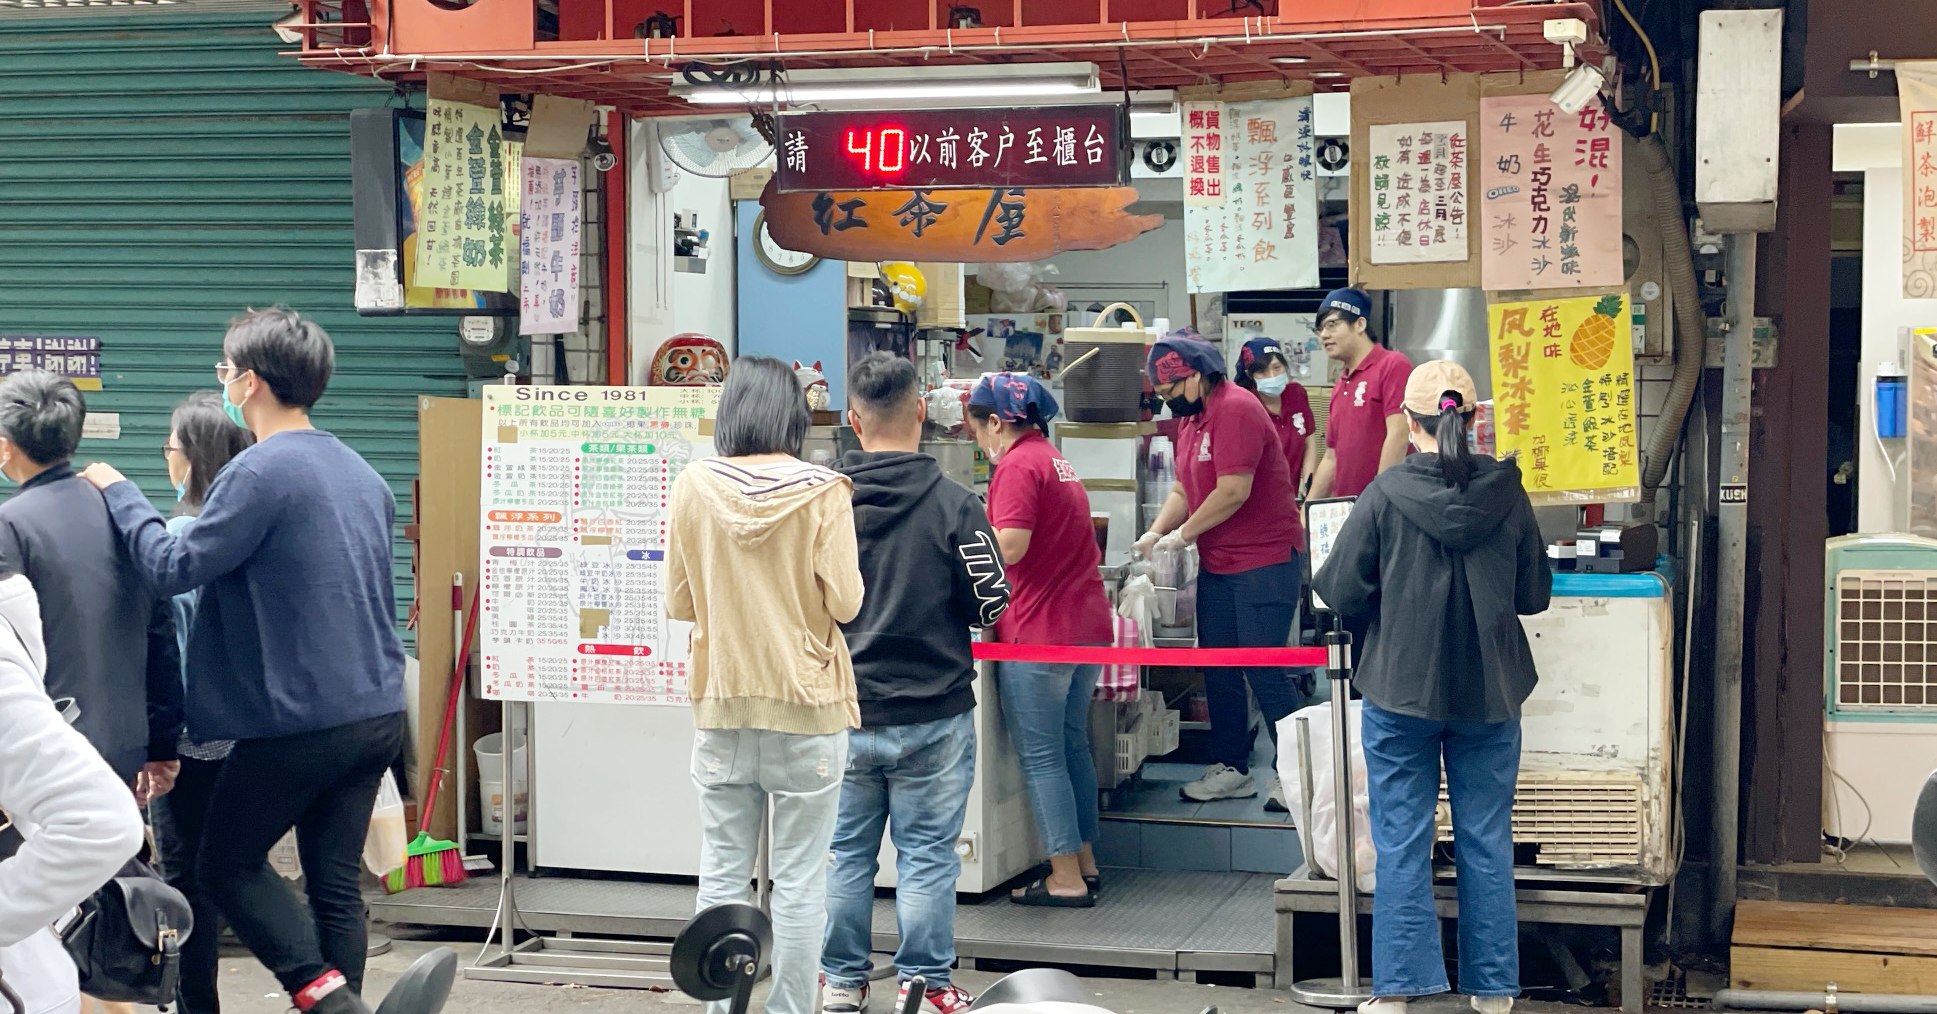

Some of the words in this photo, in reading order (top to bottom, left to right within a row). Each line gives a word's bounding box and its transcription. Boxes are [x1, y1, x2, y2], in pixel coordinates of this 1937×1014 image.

[785, 133, 809, 174] 請
[847, 129, 904, 171] 40
[1189, 110, 1205, 196] 概不退換
[1205, 111, 1221, 196] 貨物售出
[1497, 112, 1521, 175] 牛奶
[1247, 117, 1279, 264] 飄浮系列飲
[1531, 109, 1555, 276] 花生巧克力冰沙
[1915, 121, 1937, 244] 鮮茶泡製
[1233, 320, 1262, 328] TECO
[497, 404, 706, 418] 標記飲品可隨喜好製作無糖
[516, 387, 589, 401] Since
[601, 390, 647, 401] 1981
[642, 551, 651, 560] 冰
